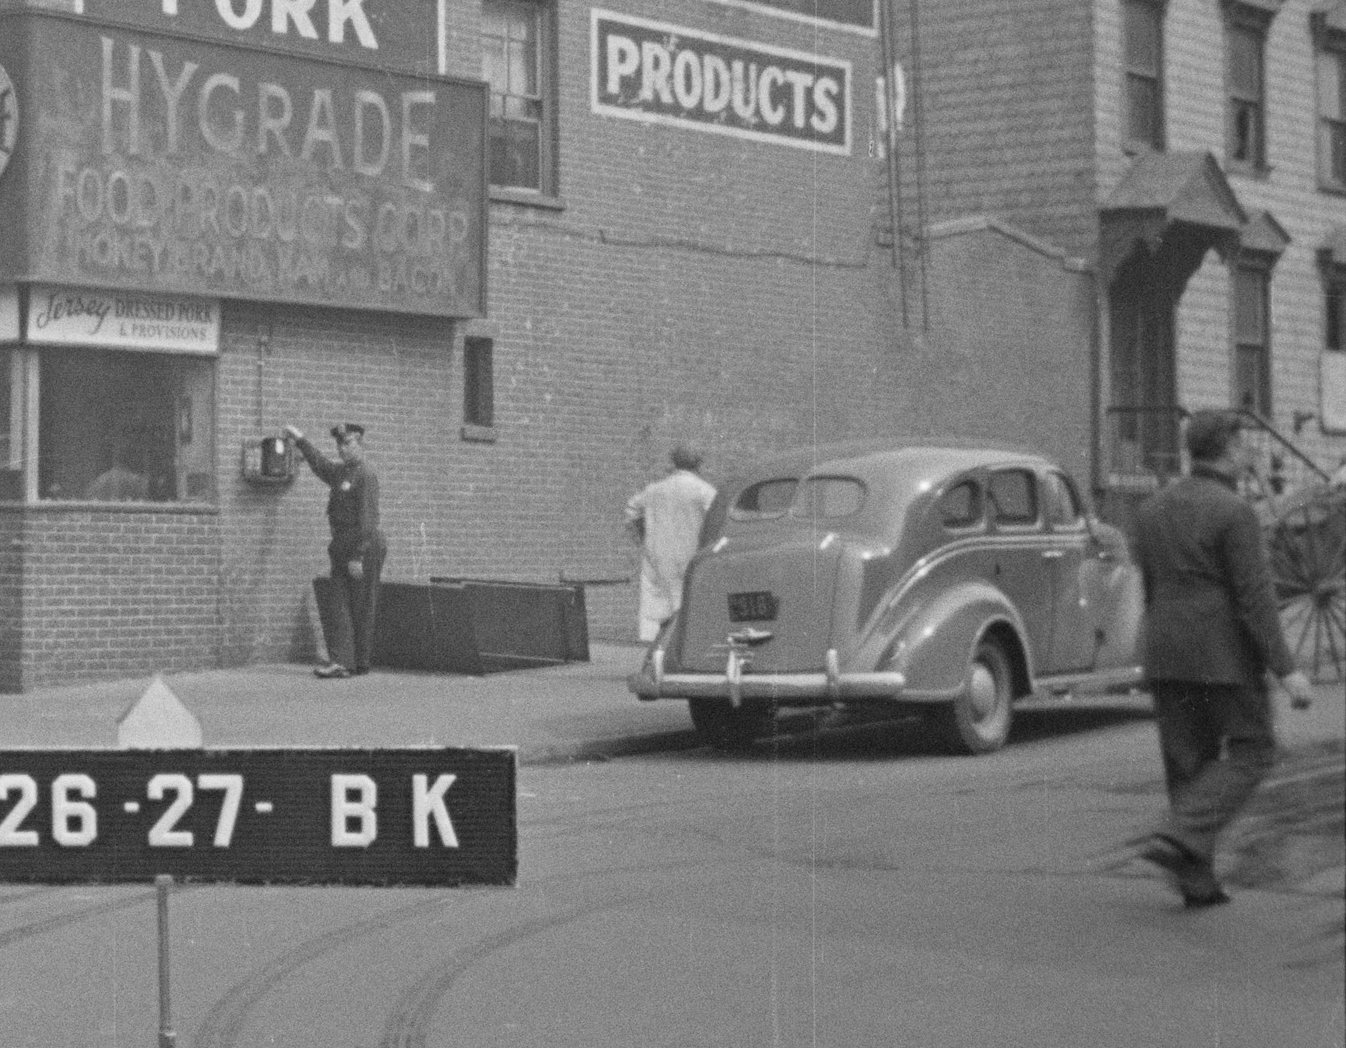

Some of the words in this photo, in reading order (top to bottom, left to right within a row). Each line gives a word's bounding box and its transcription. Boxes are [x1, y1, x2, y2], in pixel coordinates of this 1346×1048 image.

[100, 35, 437, 193] HYGRADE
[607, 34, 840, 134] PRODUCTS
[57, 164, 157, 228] FOOD
[175, 176, 365, 250] PRODUCTS
[37, 294, 112, 336] Jersey
[132, 323, 207, 341] PROVISIONS
